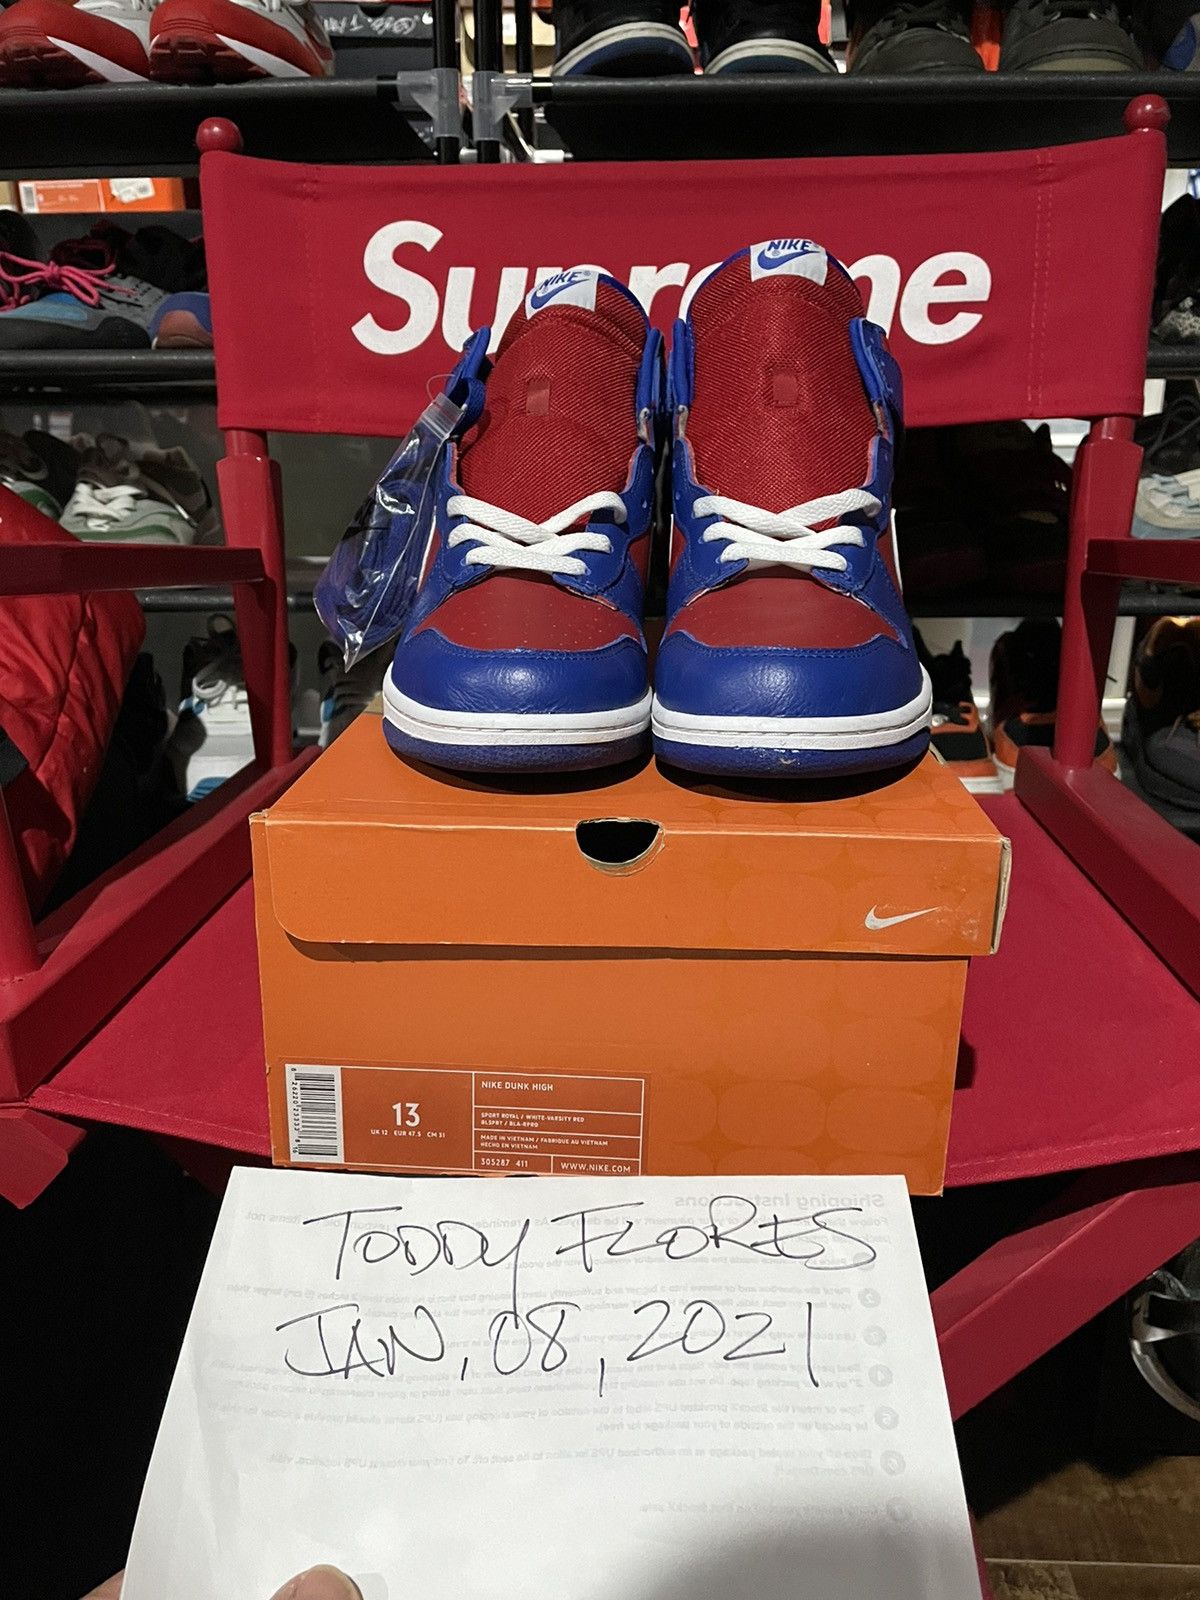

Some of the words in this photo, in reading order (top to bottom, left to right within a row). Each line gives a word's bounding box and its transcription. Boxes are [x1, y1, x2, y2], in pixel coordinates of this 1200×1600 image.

[351, 219, 992, 356] Sure
[481, 1080, 502, 1090] NIKE
[504, 1082, 529, 1091] DUNK
[532, 1083, 554, 1092] HIGH
[391, 1102, 421, 1127] 13
[580, 1139, 608, 1147] VIETNAM
[515, 1161, 528, 1169] 411
[560, 1162, 631, 1174] WWW.NIKE.COM
[303, 1205, 530, 1329] TODDY
[551, 1195, 877, 1273] FLORES
[626, 1299, 820, 1388] 2021
